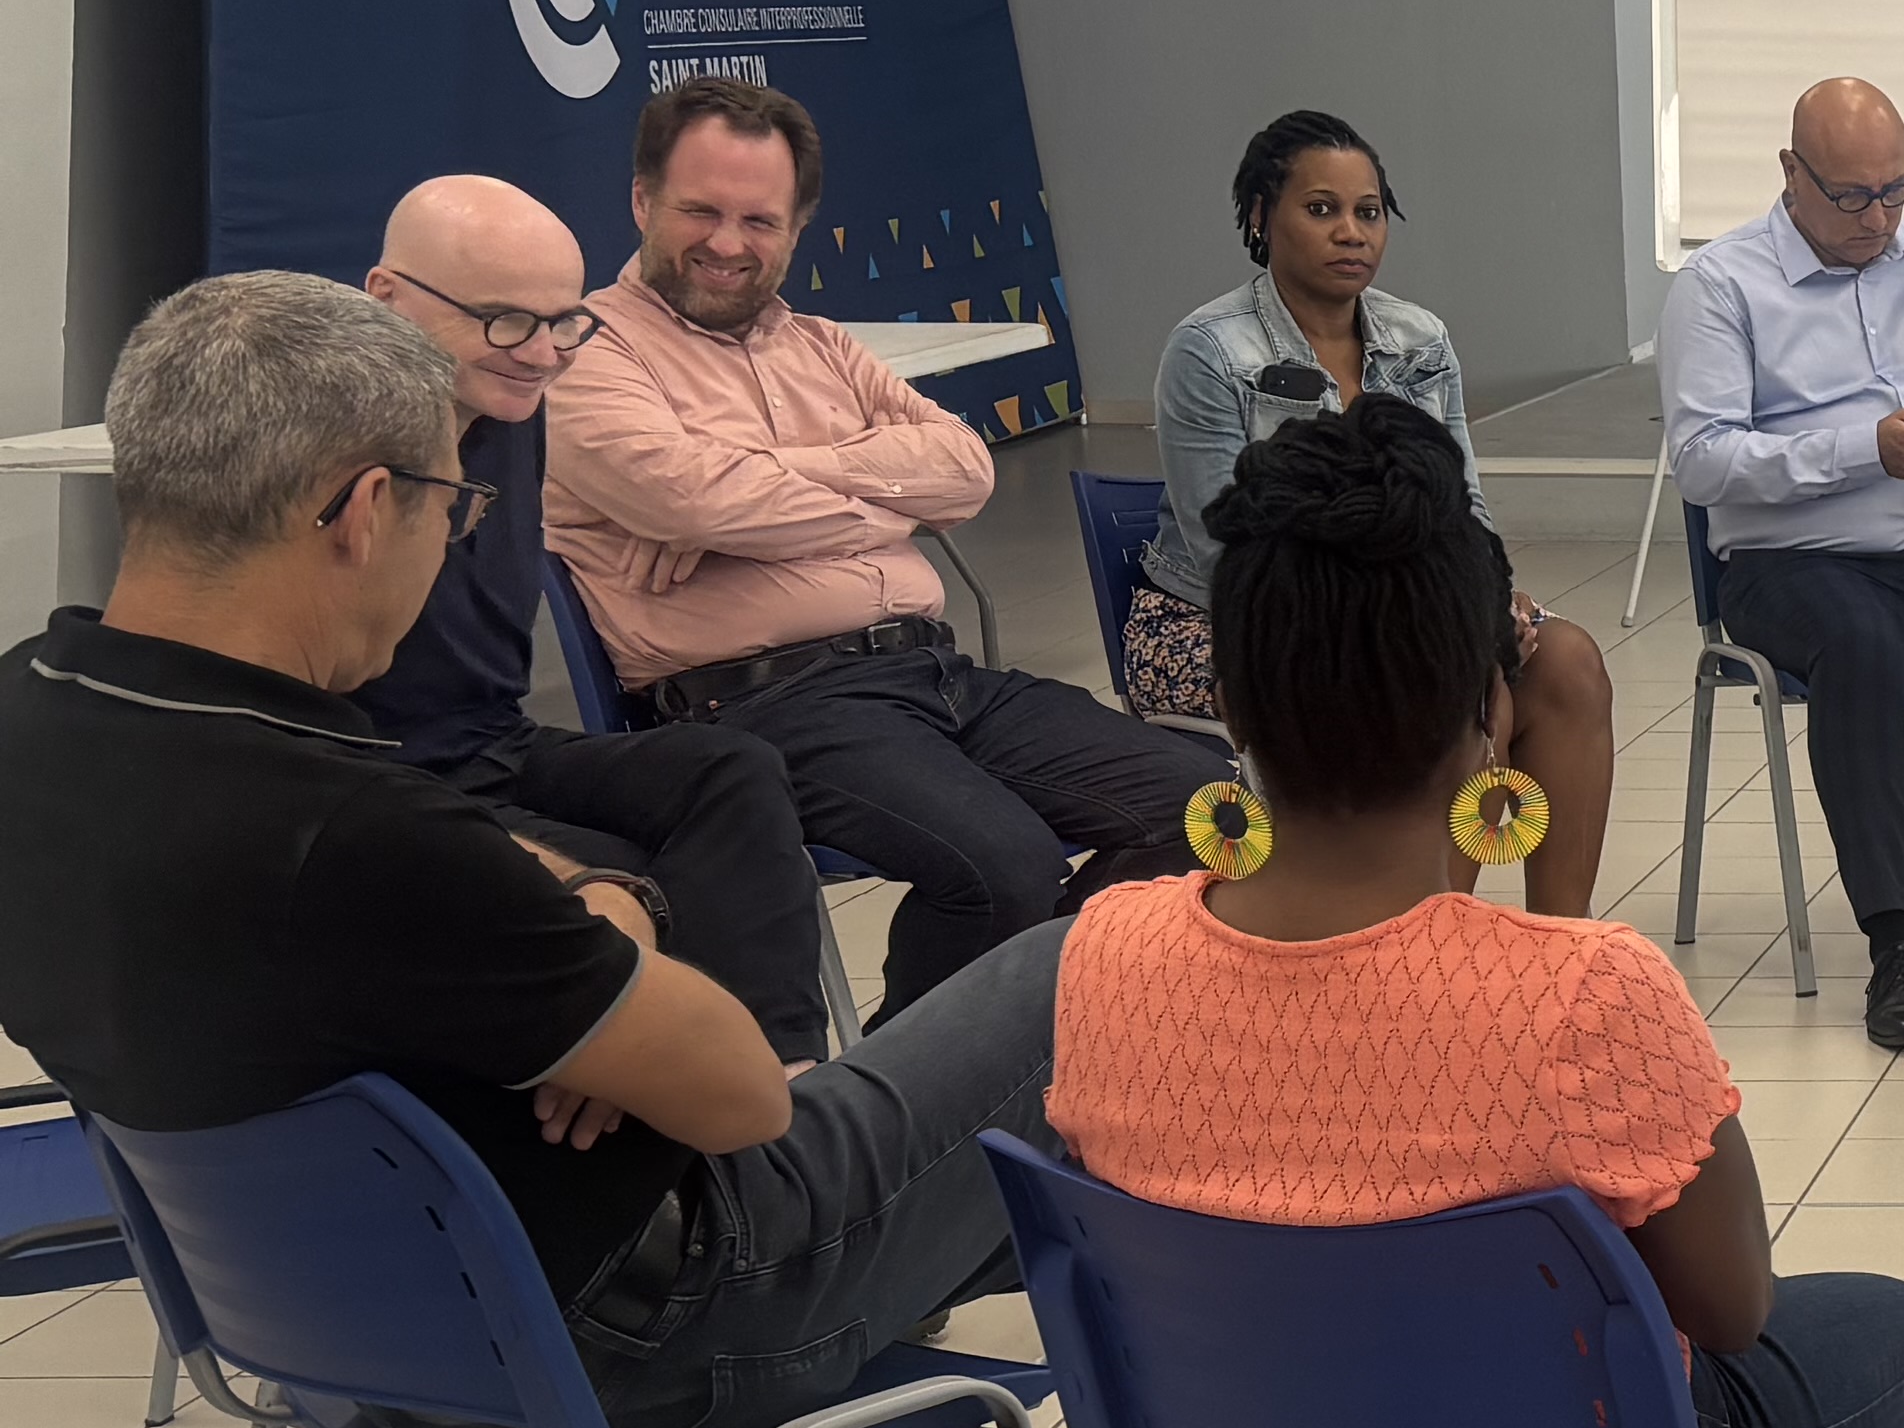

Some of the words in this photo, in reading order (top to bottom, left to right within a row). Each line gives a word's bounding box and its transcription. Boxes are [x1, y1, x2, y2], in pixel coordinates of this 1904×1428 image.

[643, 9, 697, 34] CHAMBRE
[698, 8, 760, 32] CONSULAIRE
[760, 6, 865, 29] INTERPROFESSIONNELLE
